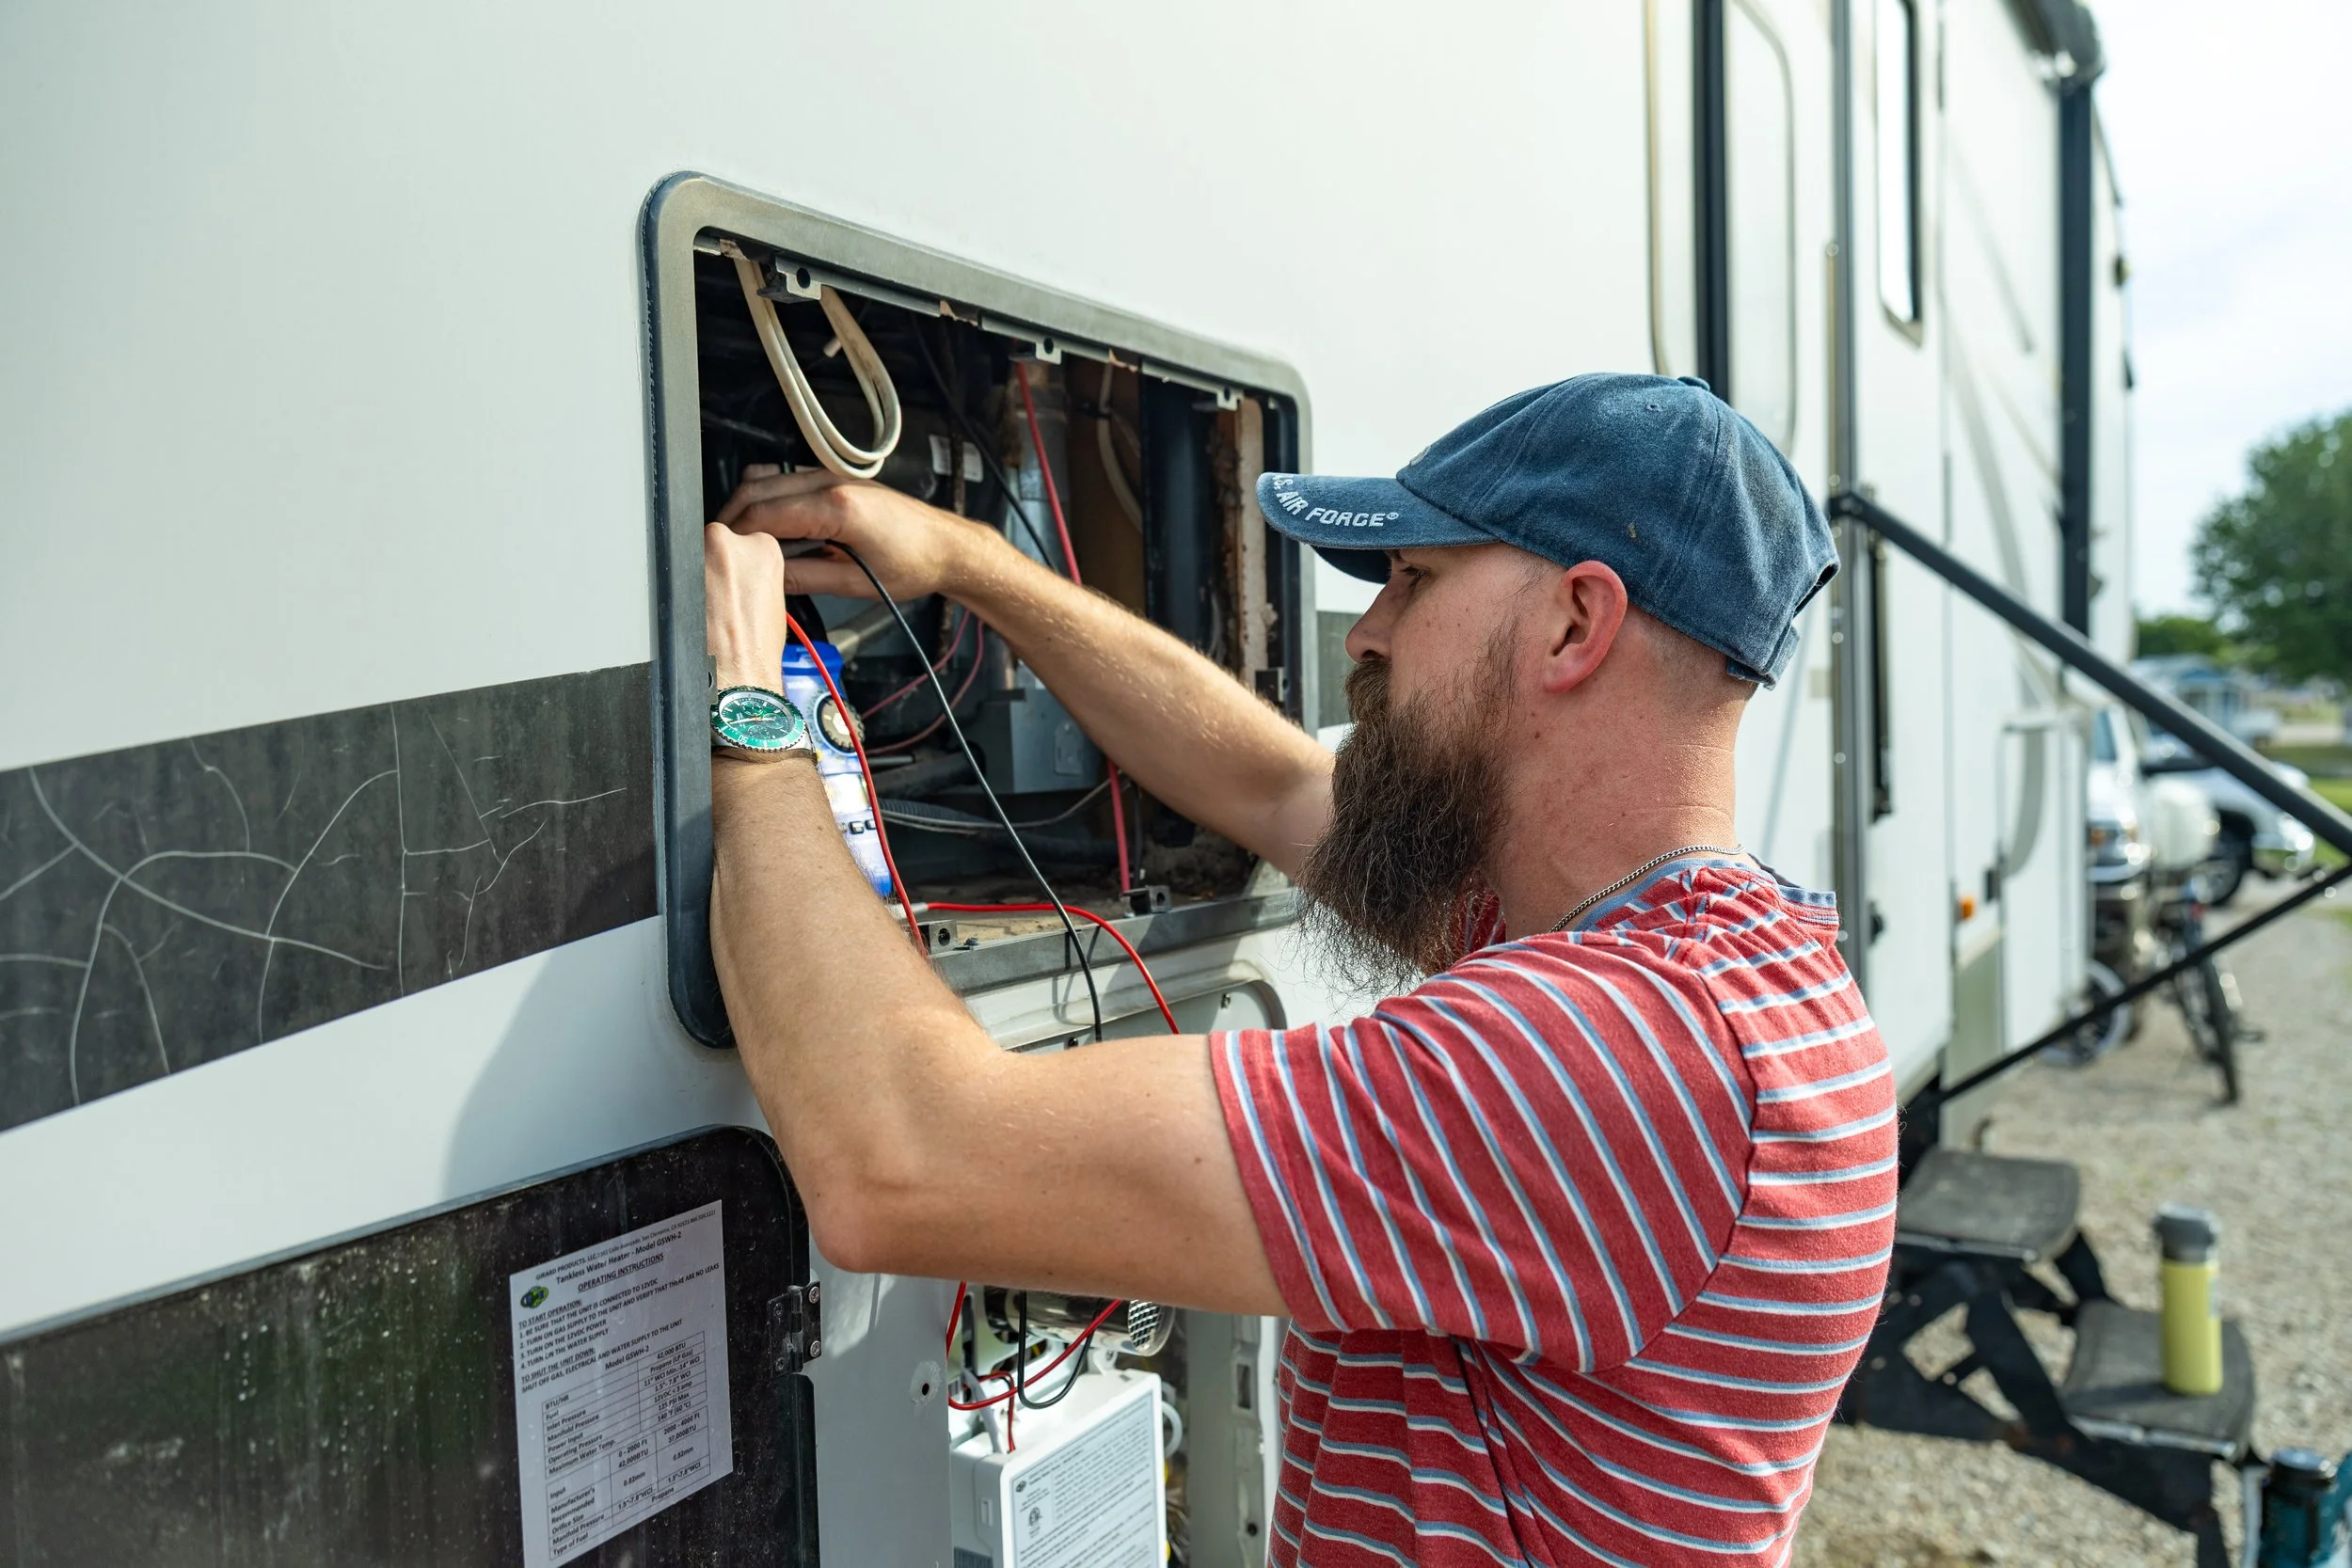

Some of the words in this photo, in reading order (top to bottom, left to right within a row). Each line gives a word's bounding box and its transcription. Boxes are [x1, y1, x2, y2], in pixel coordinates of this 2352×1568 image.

[1276, 492, 1309, 515] AIR
[557, 1269, 585, 1285] Tankless
[587, 1260, 607, 1274] Water
[608, 1251, 630, 1265] Heater
[635, 1240, 656, 1256] Model
[657, 1231, 682, 1247] GSWH-2
[578, 1269, 616, 1292] OPERATING
[617, 1252, 664, 1275] INSTRUCTIONS
[526, 1326, 533, 1336] BE
[534, 1321, 549, 1331] SURE
[550, 1315, 565, 1325] THAT
[566, 1310, 578, 1320] THE
[579, 1304, 593, 1315] UNIT
[599, 1289, 631, 1307] CONNECTED
[642, 1278, 659, 1291] 12VDC
[527, 1334, 543, 1346] TURN
[544, 1330, 553, 1339] ON
[554, 1323, 566, 1335] GAS
[567, 1316, 589, 1328] SUPPLY
[589, 1312, 596, 1322] TO
[597, 1307, 608, 1317] THE
[609, 1301, 622, 1312] UNIT
[623, 1297, 635, 1307] AND
[636, 1290, 654, 1302] VERIFY
[655, 1284, 668, 1293] THAT
[685, 1273, 695, 1282] ARE
[705, 1262, 720, 1273] LEAKS
[518, 1321, 528, 1329] TO
[528, 1311, 547, 1325] START
[527, 1345, 543, 1356] TURN
[544, 1340, 554, 1350] ON
[555, 1336, 565, 1346] THE
[567, 1327, 585, 1340] 12VDC
[586, 1319, 607, 1332] POWER
[527, 1355, 544, 1368] TURN
[545, 1351, 554, 1360] ON
[555, 1346, 565, 1355] THE
[567, 1338, 588, 1350] WATER
[589, 1328, 609, 1341] SUPPLY
[522, 1383, 538, 1393] SHUT
[539, 1377, 549, 1386] OFF
[565, 1357, 596, 1374] ELECTRICAL
[597, 1350, 611, 1360] AND
[612, 1340, 630, 1354] WATER
[631, 1334, 651, 1346] SUPPLY
[660, 1324, 670, 1334] THE
[671, 1319, 683, 1329] UNIT
[605, 1355, 625, 1370] Model
[626, 1345, 650, 1361] GSWH-2
[650, 1359, 673, 1373] Propane
[673, 1354, 682, 1365] (LP
[682, 1348, 693, 1359] Gas)
[657, 1346, 675, 1360] 42,000
[675, 1342, 687, 1352] BTU
[521, 1375, 531, 1384] TO
[532, 1368, 547, 1380] SHUT
[548, 1362, 559, 1372] THE
[560, 1355, 574, 1368] UNIT
[546, 1394, 569, 1410] BTU/HR
[654, 1389, 672, 1402] 12VDC
[680, 1380, 693, 1390] amp
[659, 1402, 668, 1411] 125
[669, 1398, 677, 1407] PSI
[678, 1392, 690, 1402] Max
[546, 1410, 559, 1420] Fuel
[547, 1420, 561, 1432] Inlet
[562, 1409, 587, 1424] Pressure
[658, 1411, 667, 1421] 140
[664, 1424, 677, 1435] 2000
[681, 1416, 693, 1427] 4000
[694, 1412, 700, 1421] Ft
[548, 1425, 574, 1443] Manifold
[575, 1414, 600, 1430] Pressure
[548, 1441, 567, 1453] Power
[568, 1432, 583, 1444] Input
[548, 1446, 578, 1465] Operating
[579, 1433, 603, 1449] Pressure
[627, 1442, 641, 1453] 2000
[642, 1438, 648, 1448] Ft
[548, 1456, 579, 1475] Maximum
[580, 1446, 597, 1460] Water
[598, 1439, 616, 1450] Temp.
[550, 1486, 566, 1499] Input
[550, 1486, 596, 1514] Manufacturer's
[651, 1486, 675, 1503] Propane
[551, 1497, 595, 1524] Recommended
[551, 1518, 572, 1535] Orifice
[573, 1513, 584, 1524] Size
[552, 1525, 580, 1545] Manifold
[580, 1513, 605, 1532] Pressure
[553, 1543, 567, 1556] Type
[568, 1539, 576, 1548] of
[576, 1532, 589, 1544] Fuel
